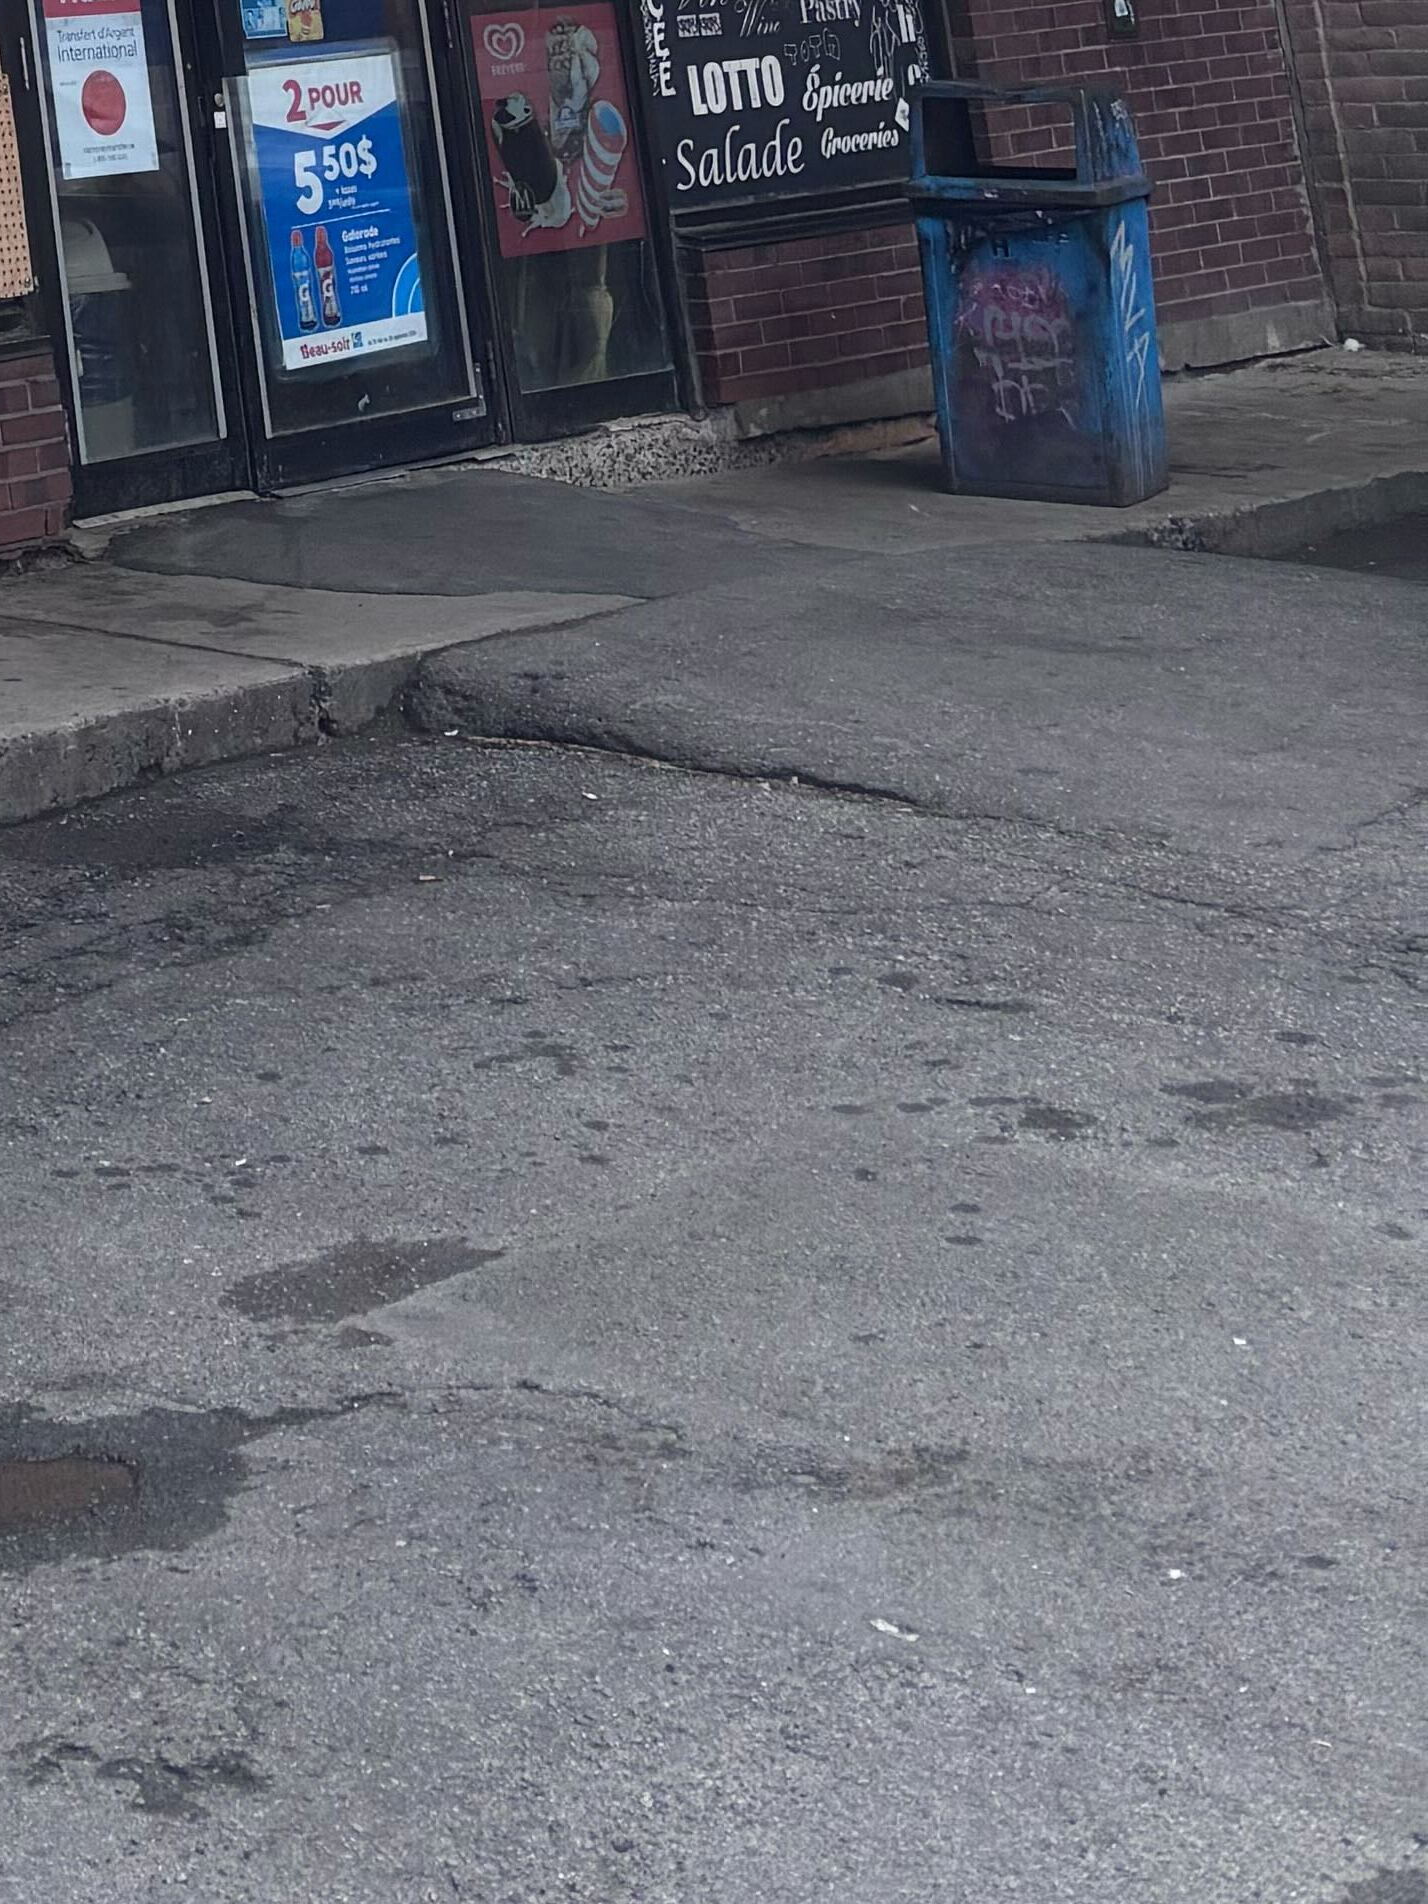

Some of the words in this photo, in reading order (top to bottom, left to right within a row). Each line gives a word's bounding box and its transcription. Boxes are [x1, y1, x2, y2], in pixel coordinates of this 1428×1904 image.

[57, 40, 138, 63] International
[281, 79, 308, 124] 2
[307, 80, 364, 111] POUR
[686, 54, 785, 116] LOTTO
[802, 63, 894, 122] Épicerie
[676, 118, 805, 191] Salade
[821, 121, 899, 159] Groceries
